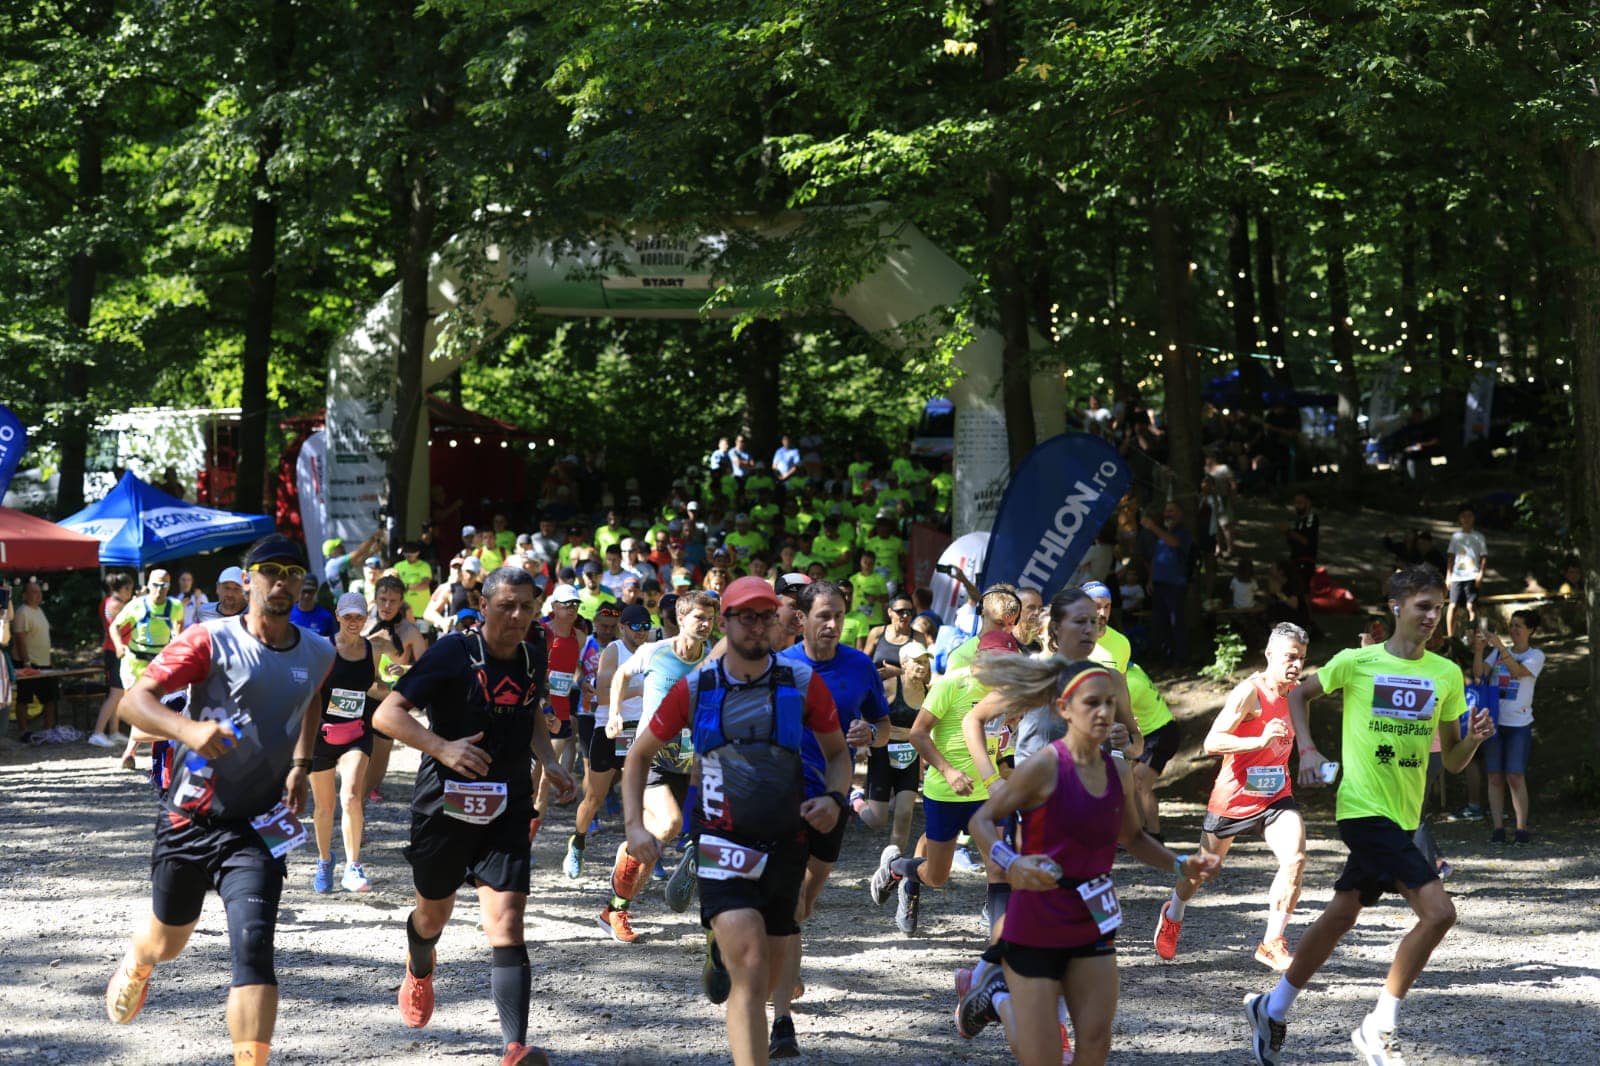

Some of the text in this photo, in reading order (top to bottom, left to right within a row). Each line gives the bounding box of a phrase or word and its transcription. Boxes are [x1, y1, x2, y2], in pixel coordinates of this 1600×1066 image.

[643, 278, 685, 287] START
[339, 700, 357, 710] 270
[1392, 689, 1416, 708] 60
[898, 752, 912, 762] 215
[1257, 777, 1276, 788] 123
[464, 797, 486, 813] 53
[278, 819, 295, 835] 5
[718, 848, 745, 869] 30
